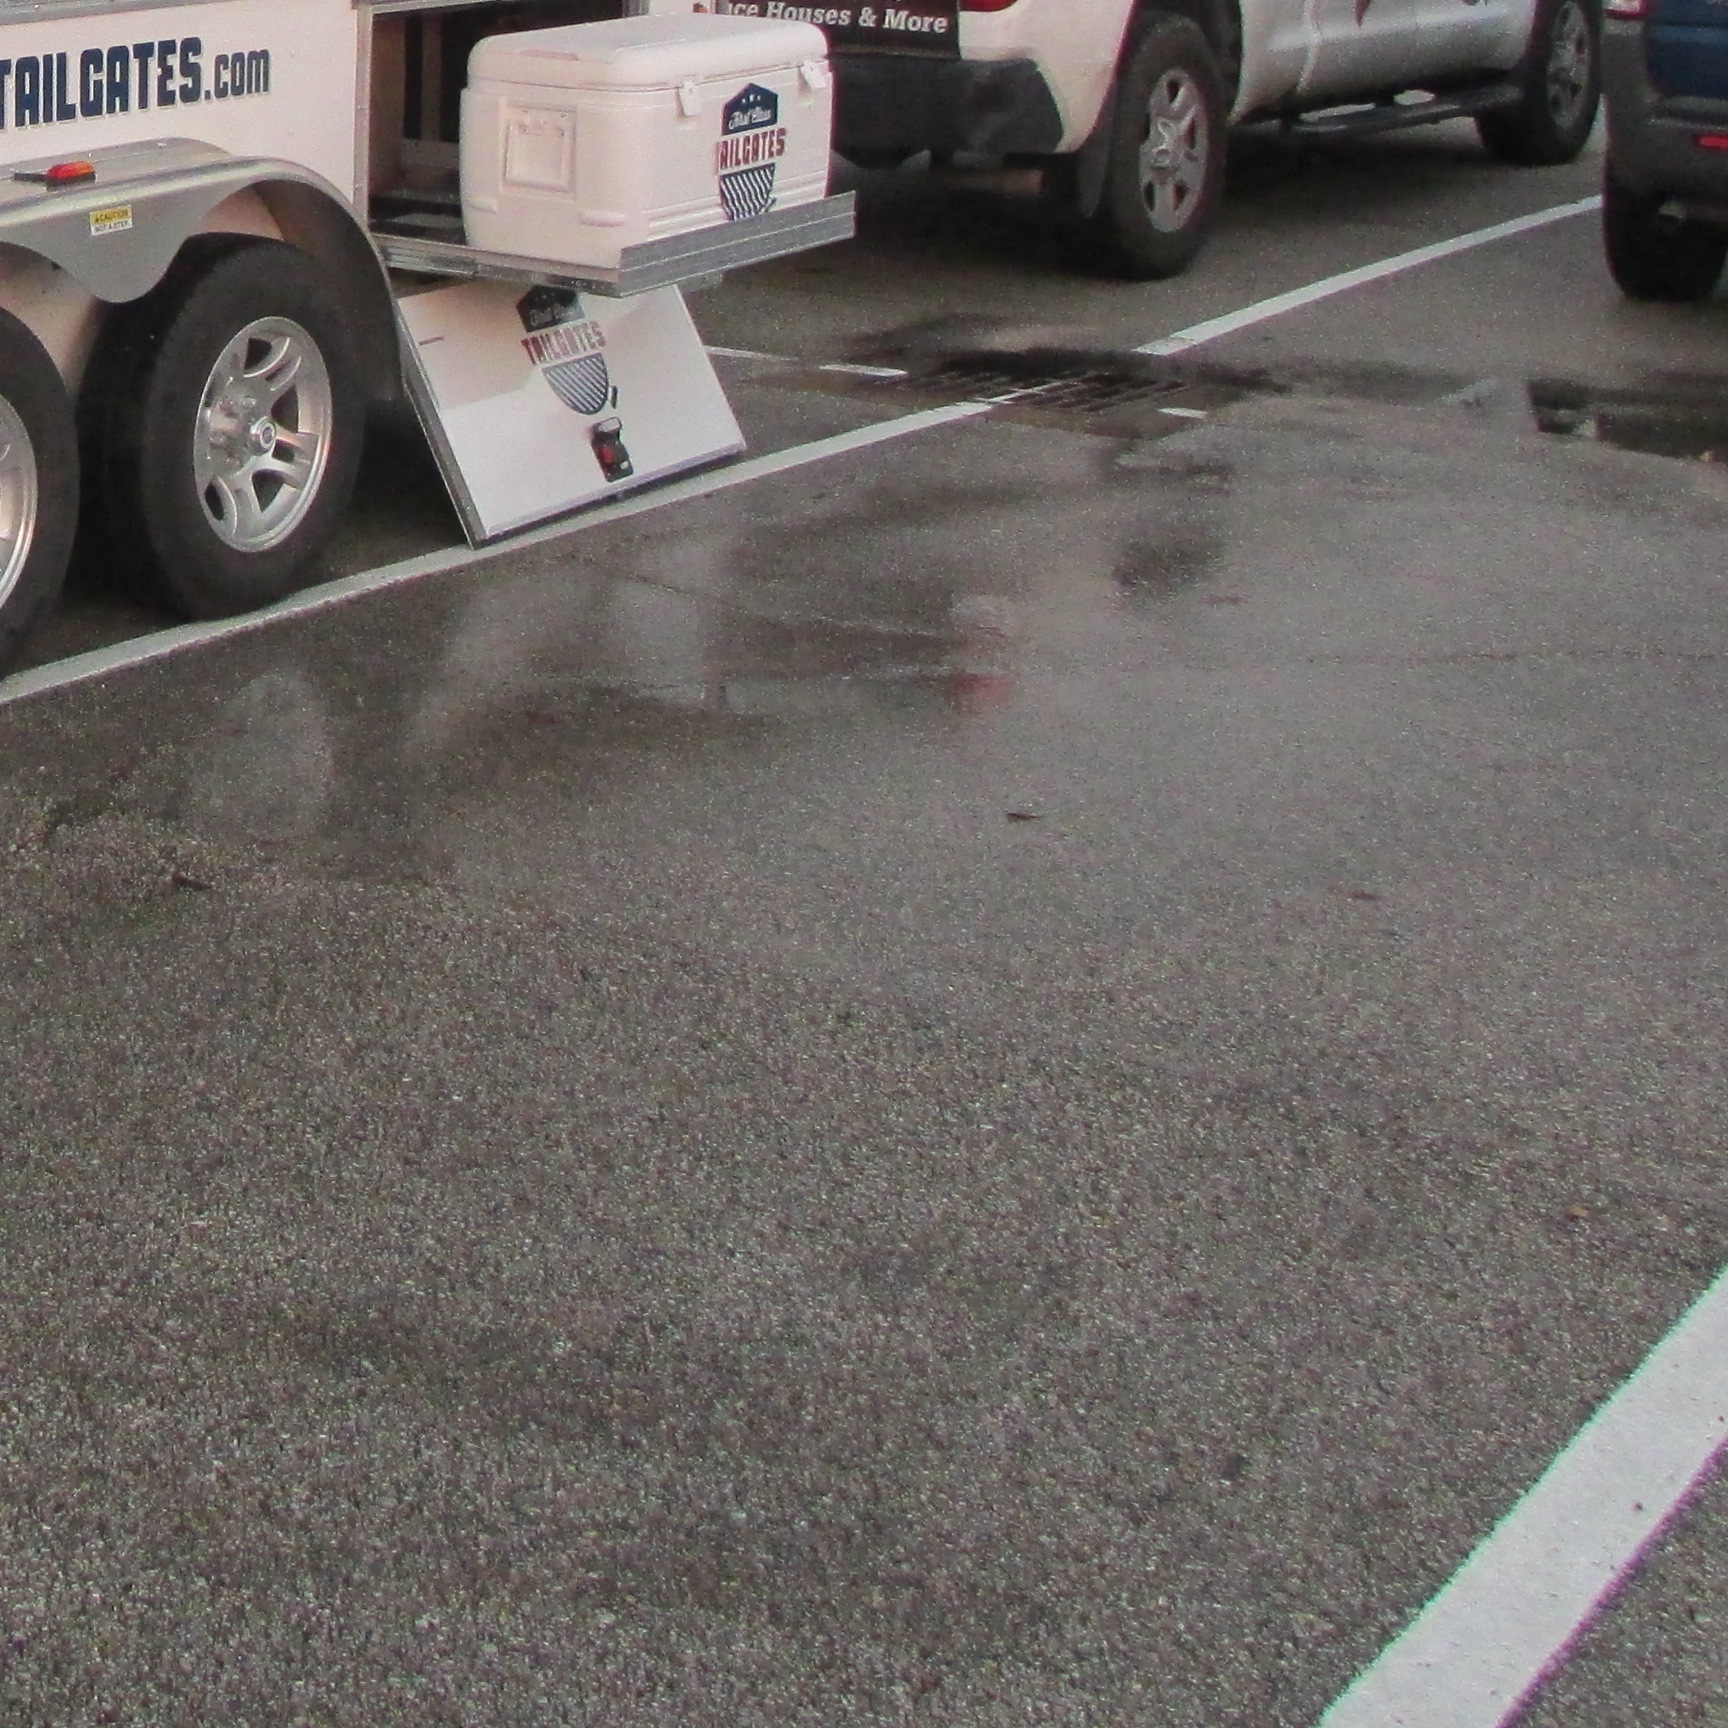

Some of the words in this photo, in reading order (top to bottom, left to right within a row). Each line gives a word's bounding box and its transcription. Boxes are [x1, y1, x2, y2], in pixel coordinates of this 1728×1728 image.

[766, 1, 852, 26] Houses
[858, 7, 877, 27] &
[883, 8, 948, 33] More
